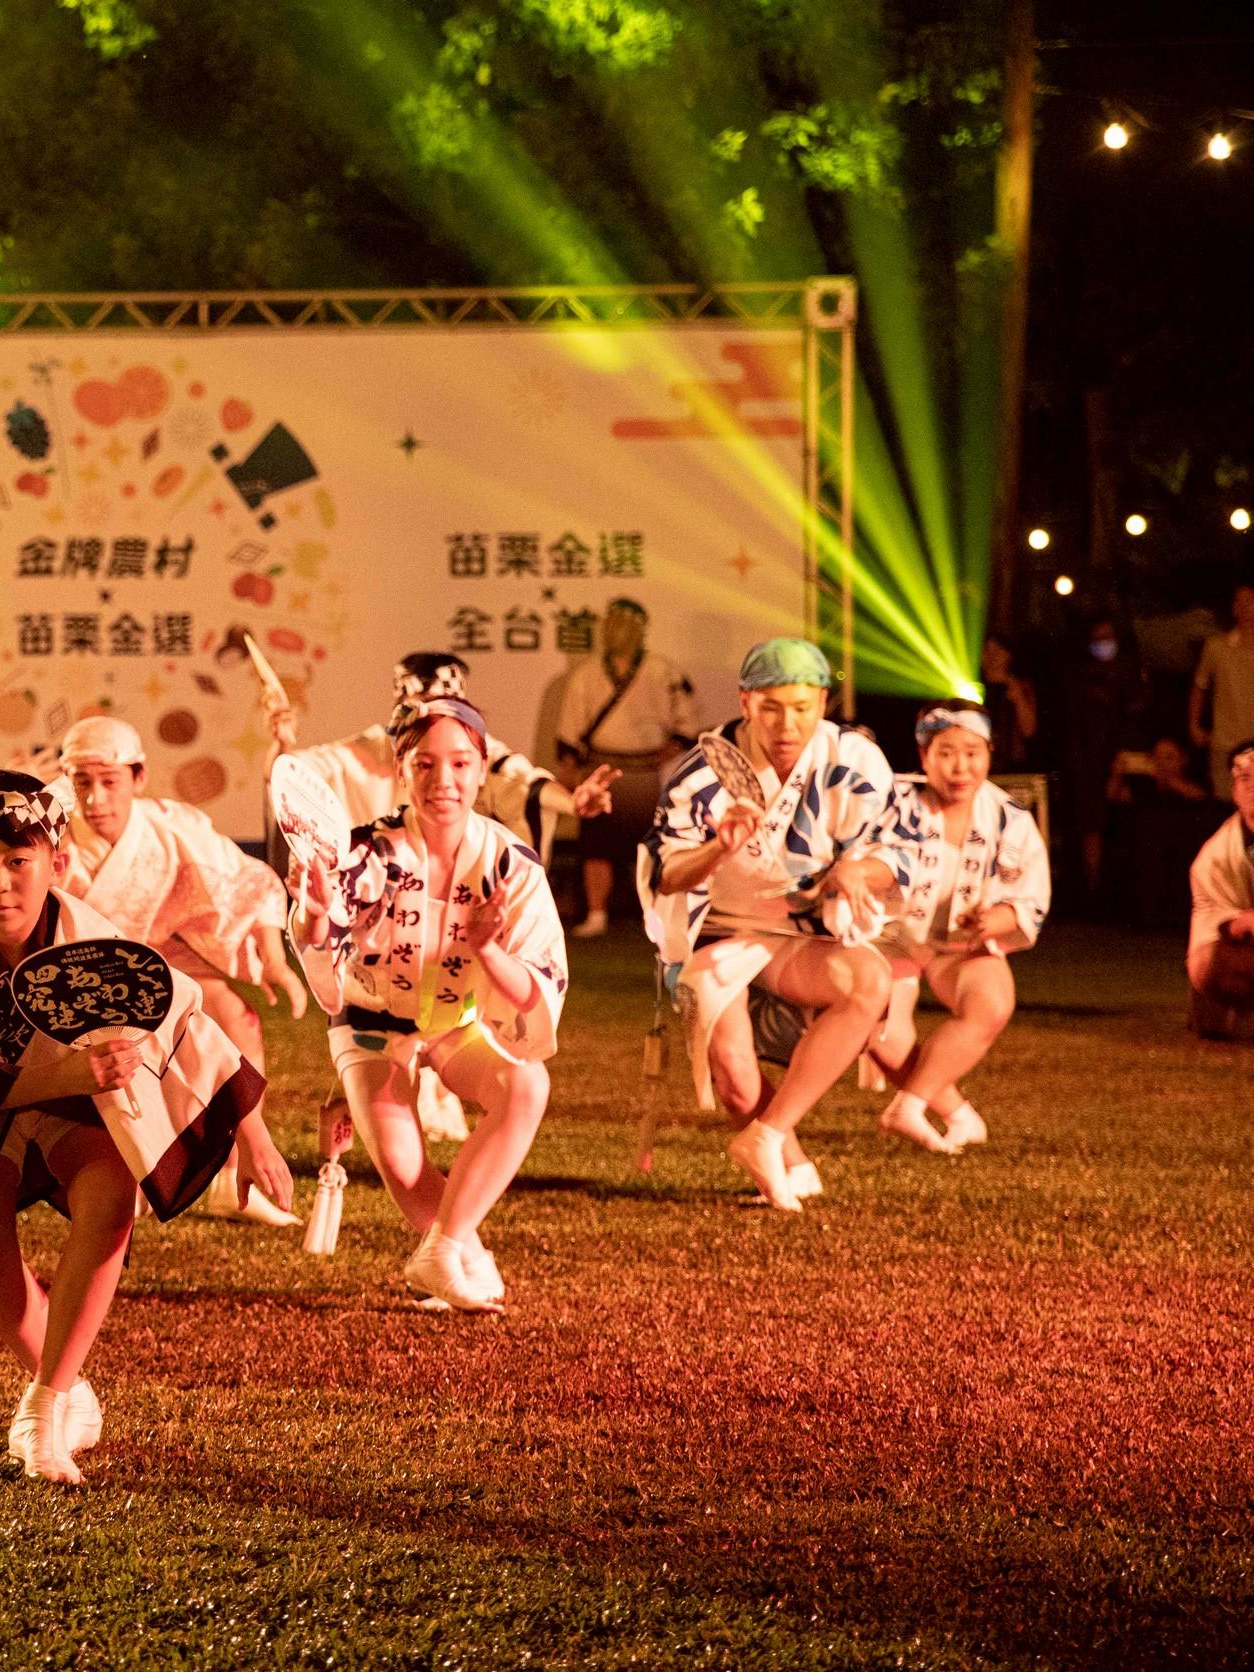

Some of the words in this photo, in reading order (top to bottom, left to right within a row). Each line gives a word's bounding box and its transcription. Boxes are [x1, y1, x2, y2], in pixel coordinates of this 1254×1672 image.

[17, 536, 194, 578] 金牌農村
[445, 532, 644, 579] 苗栗金選
[16, 611, 192, 656] 苗栗金選
[447, 604, 600, 652] 全台首
[391, 871, 425, 991] あわぞう
